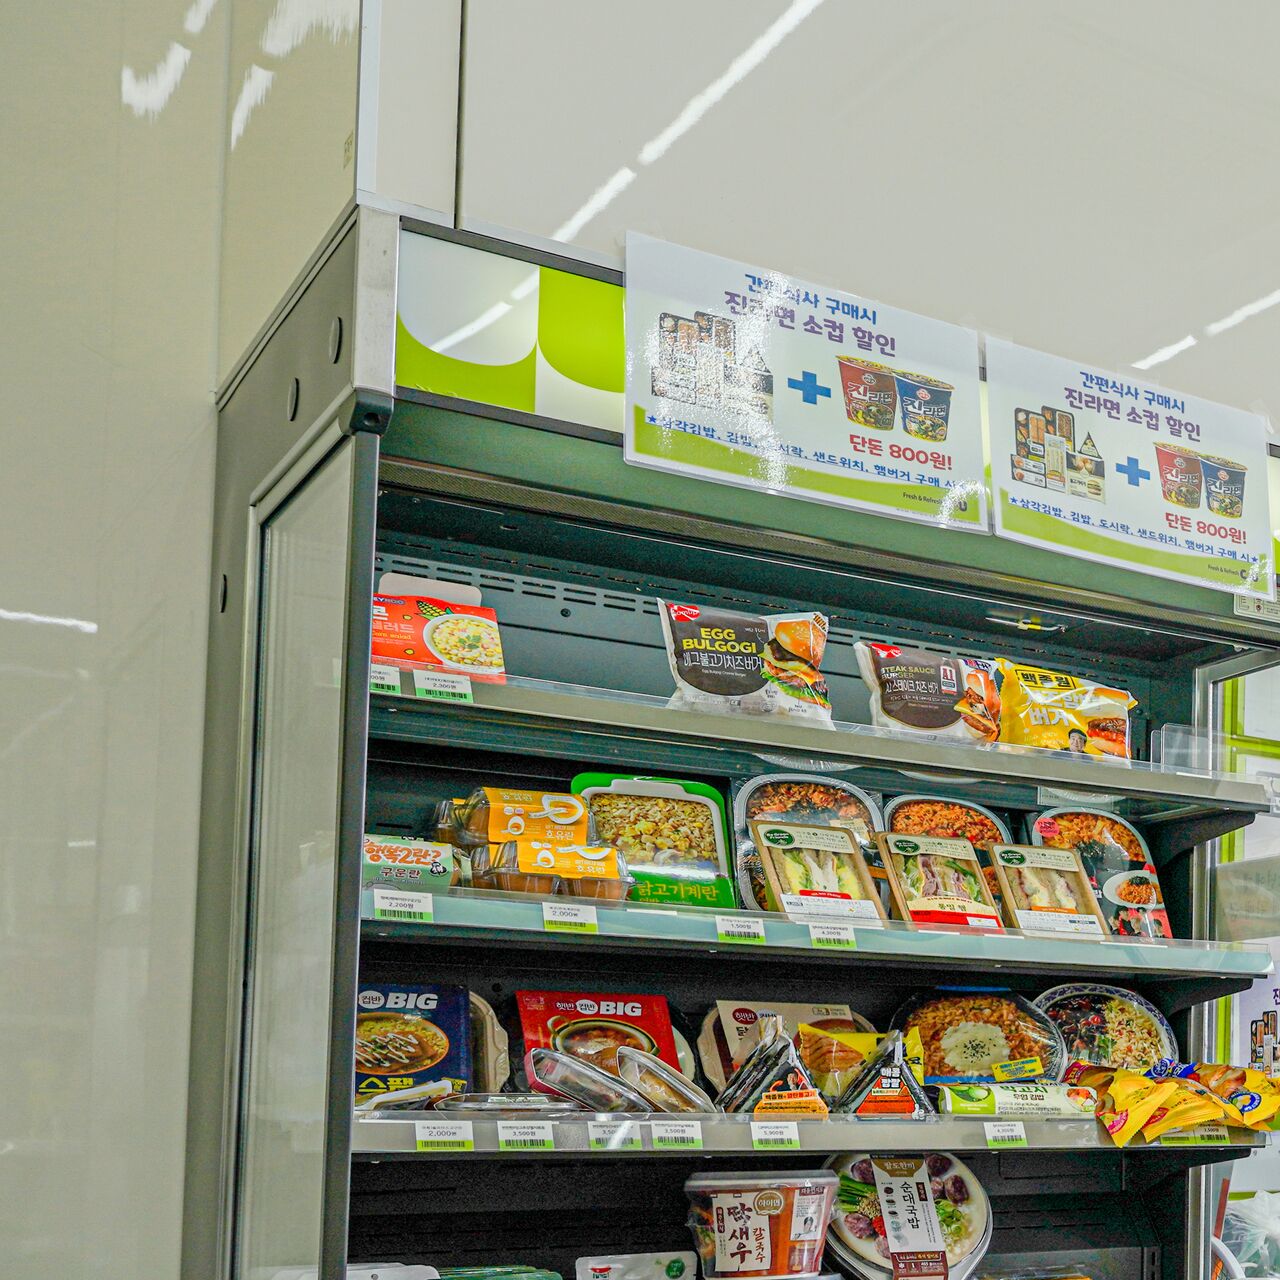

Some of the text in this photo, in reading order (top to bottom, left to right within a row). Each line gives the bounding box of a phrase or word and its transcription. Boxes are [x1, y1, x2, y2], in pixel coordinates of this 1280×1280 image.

[826, 297, 877, 325] 구매시
[802, 314, 896, 358] 소컵 할인
[847, 381, 893, 404] 진라면
[1079, 371, 1185, 414] 간편식사 구매시
[902, 397, 947, 419] 진라면
[1064, 386, 1201, 442] 진라면 소컵 할인
[849, 434, 953, 471] 단돈 800원!
[812, 450, 941, 488] 샌드위치, 햄버거 구매
[1163, 465, 1200, 486] 진라면
[1207, 476, 1242, 496] 진라면
[1069, 509, 1096, 527] 김밥,
[1099, 518, 1134, 536] 도시락,
[1137, 527, 1182, 548] 샌드위치,
[1218, 546, 1238, 561] 구매
[1165, 511, 1247, 544] 단돈 800원!
[699, 626, 736, 641] EGG
[681, 637, 758, 654] BULGOGI
[905, 666, 936, 675] SAUCE
[380, 866, 422, 878] 구운란
[635, 880, 720, 901] 닭고기계란
[385, 992, 439, 1010] BIG
[600, 1001, 642, 1017] BIG
[428, 1129, 458, 1138] 2,000원
[900, 1180, 921, 1230] 순대국밥
